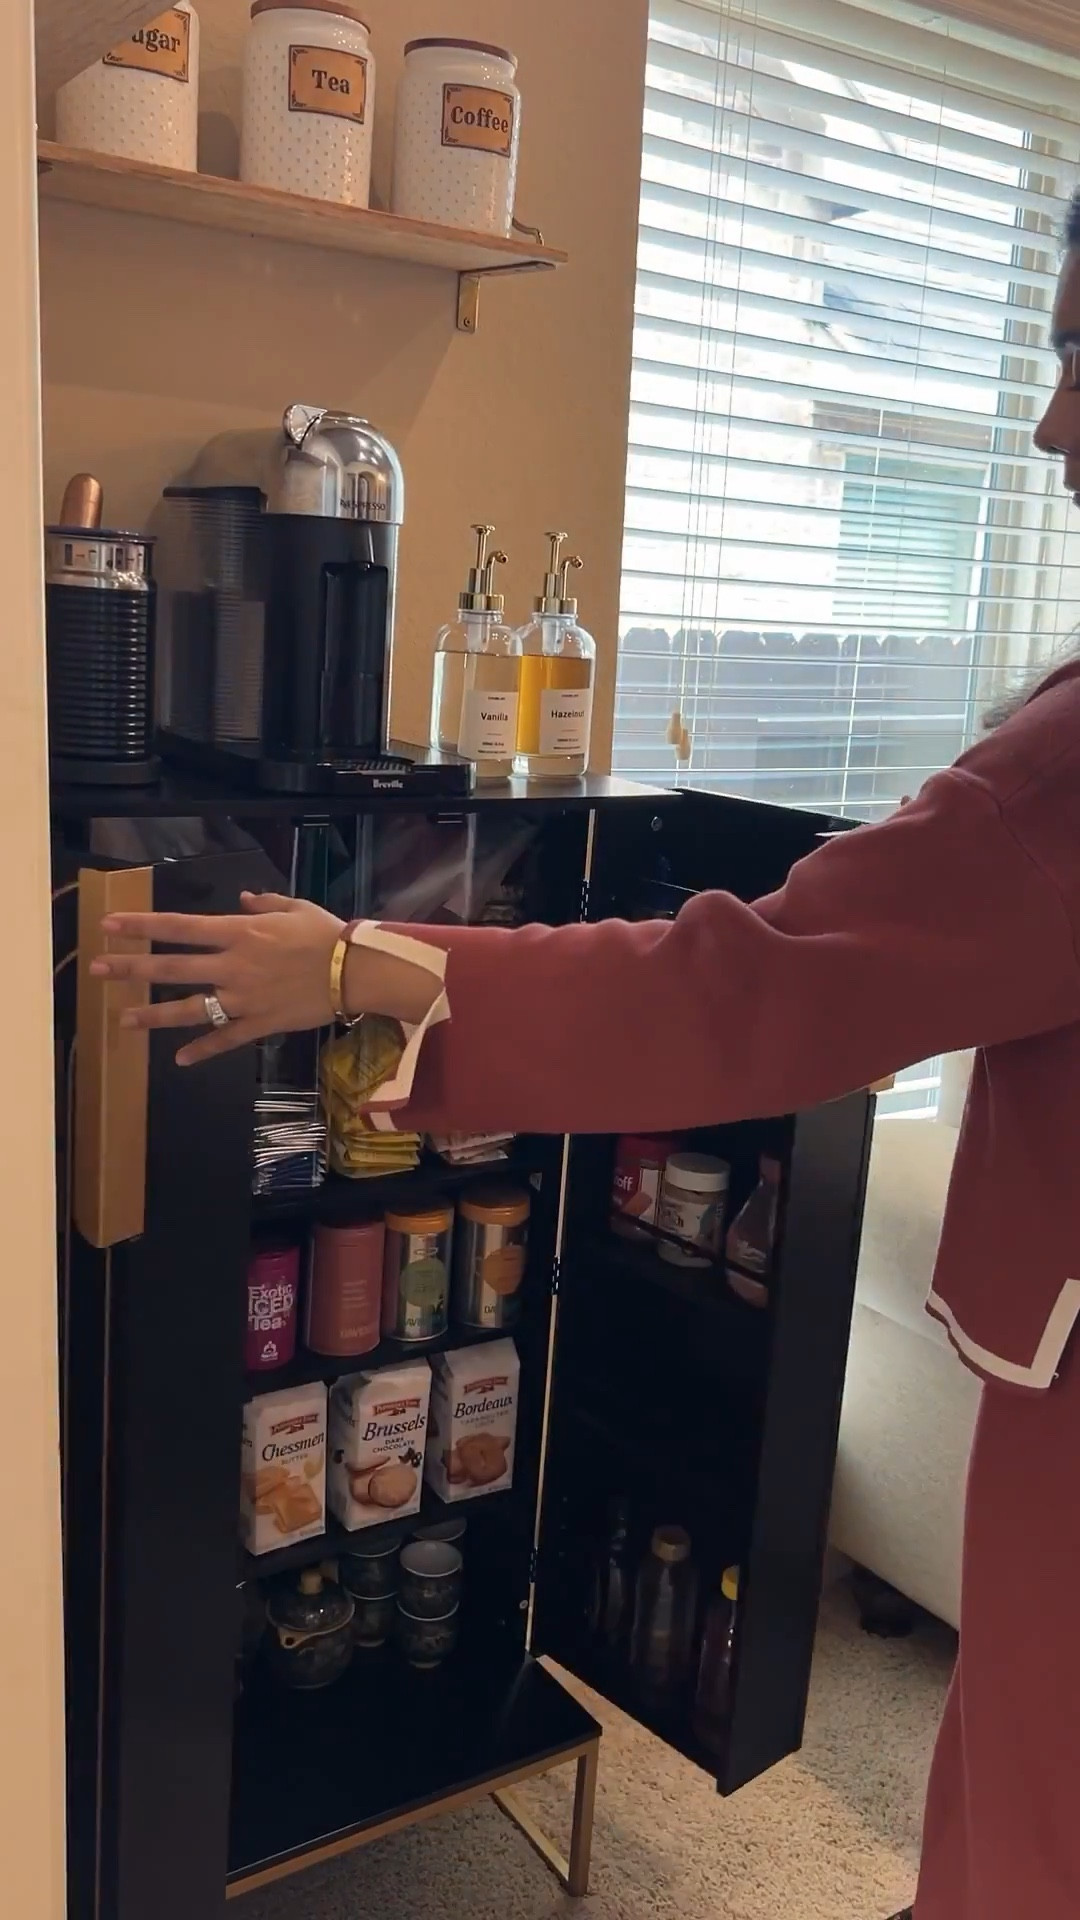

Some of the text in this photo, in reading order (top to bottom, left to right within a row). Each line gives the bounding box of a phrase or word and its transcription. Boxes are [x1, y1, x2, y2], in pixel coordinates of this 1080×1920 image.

[131, 28, 181, 53] ugar
[311, 69, 350, 95] Tea
[450, 105, 509, 133] Coffee
[480, 711, 509, 721] Vanilla
[551, 709, 585, 719] Hazelnut
[613, 1174, 634, 1192] off
[247, 1283, 293, 1300] Exotic
[248, 1293, 294, 1317] ICED
[453, 1396, 513, 1419] Bordeaux
[361, 1413, 426, 1441] Brussels
[261, 1432, 325, 1462] Chessmen
